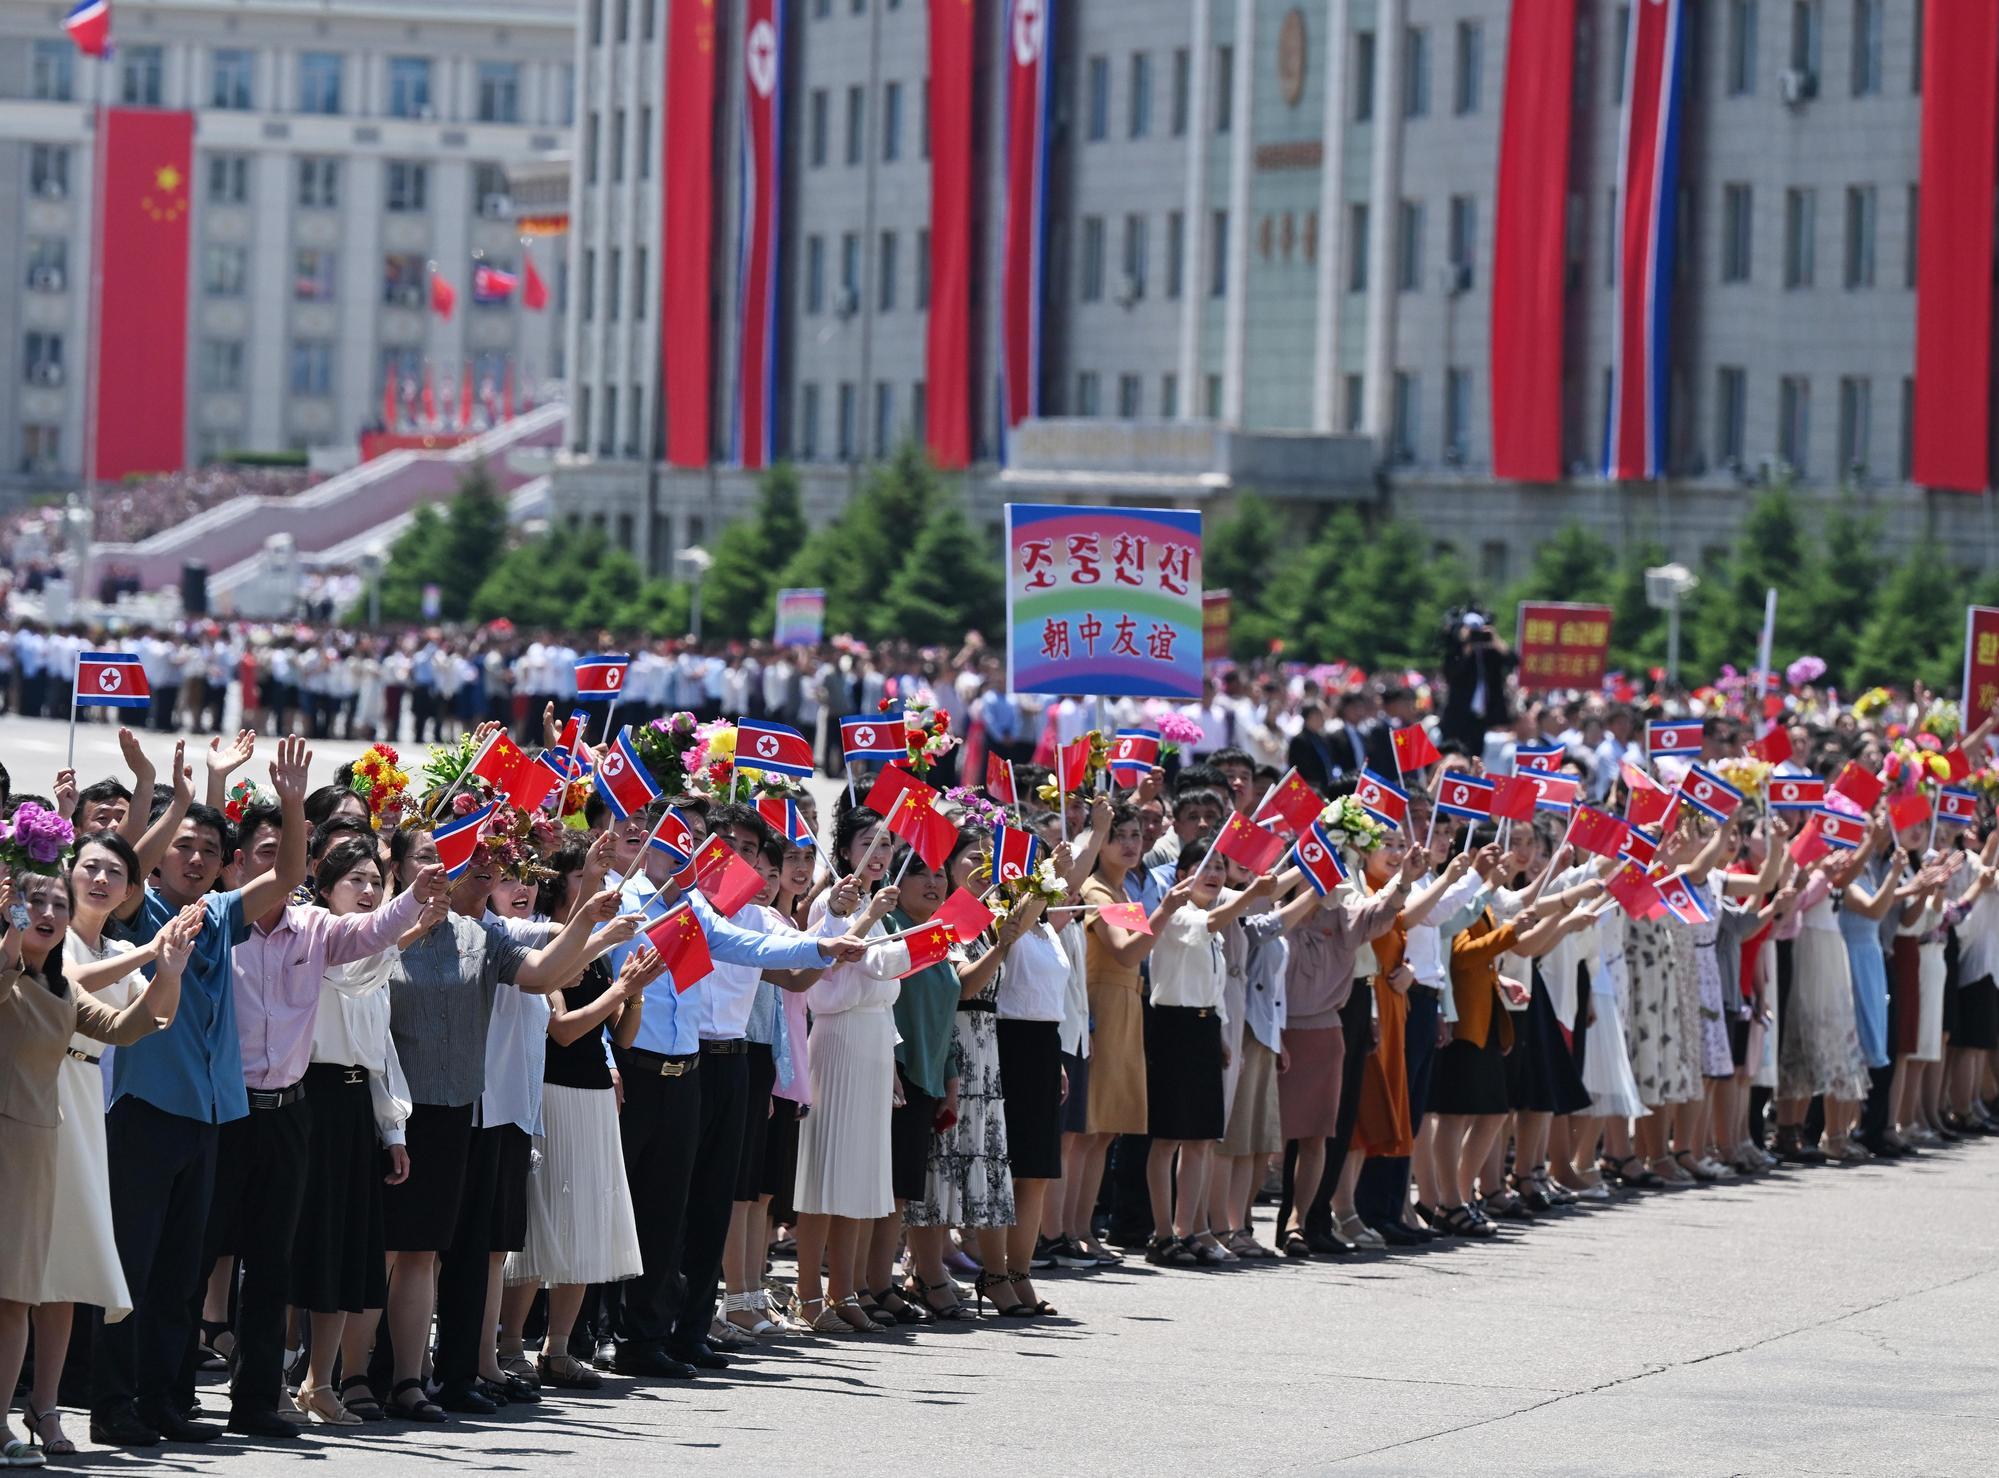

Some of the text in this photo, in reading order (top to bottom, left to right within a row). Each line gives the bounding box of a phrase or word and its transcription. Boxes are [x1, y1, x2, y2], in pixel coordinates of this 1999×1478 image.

[1021, 532, 1195, 596] 조중친선
[1040, 612, 1178, 661] 朝中友谊
